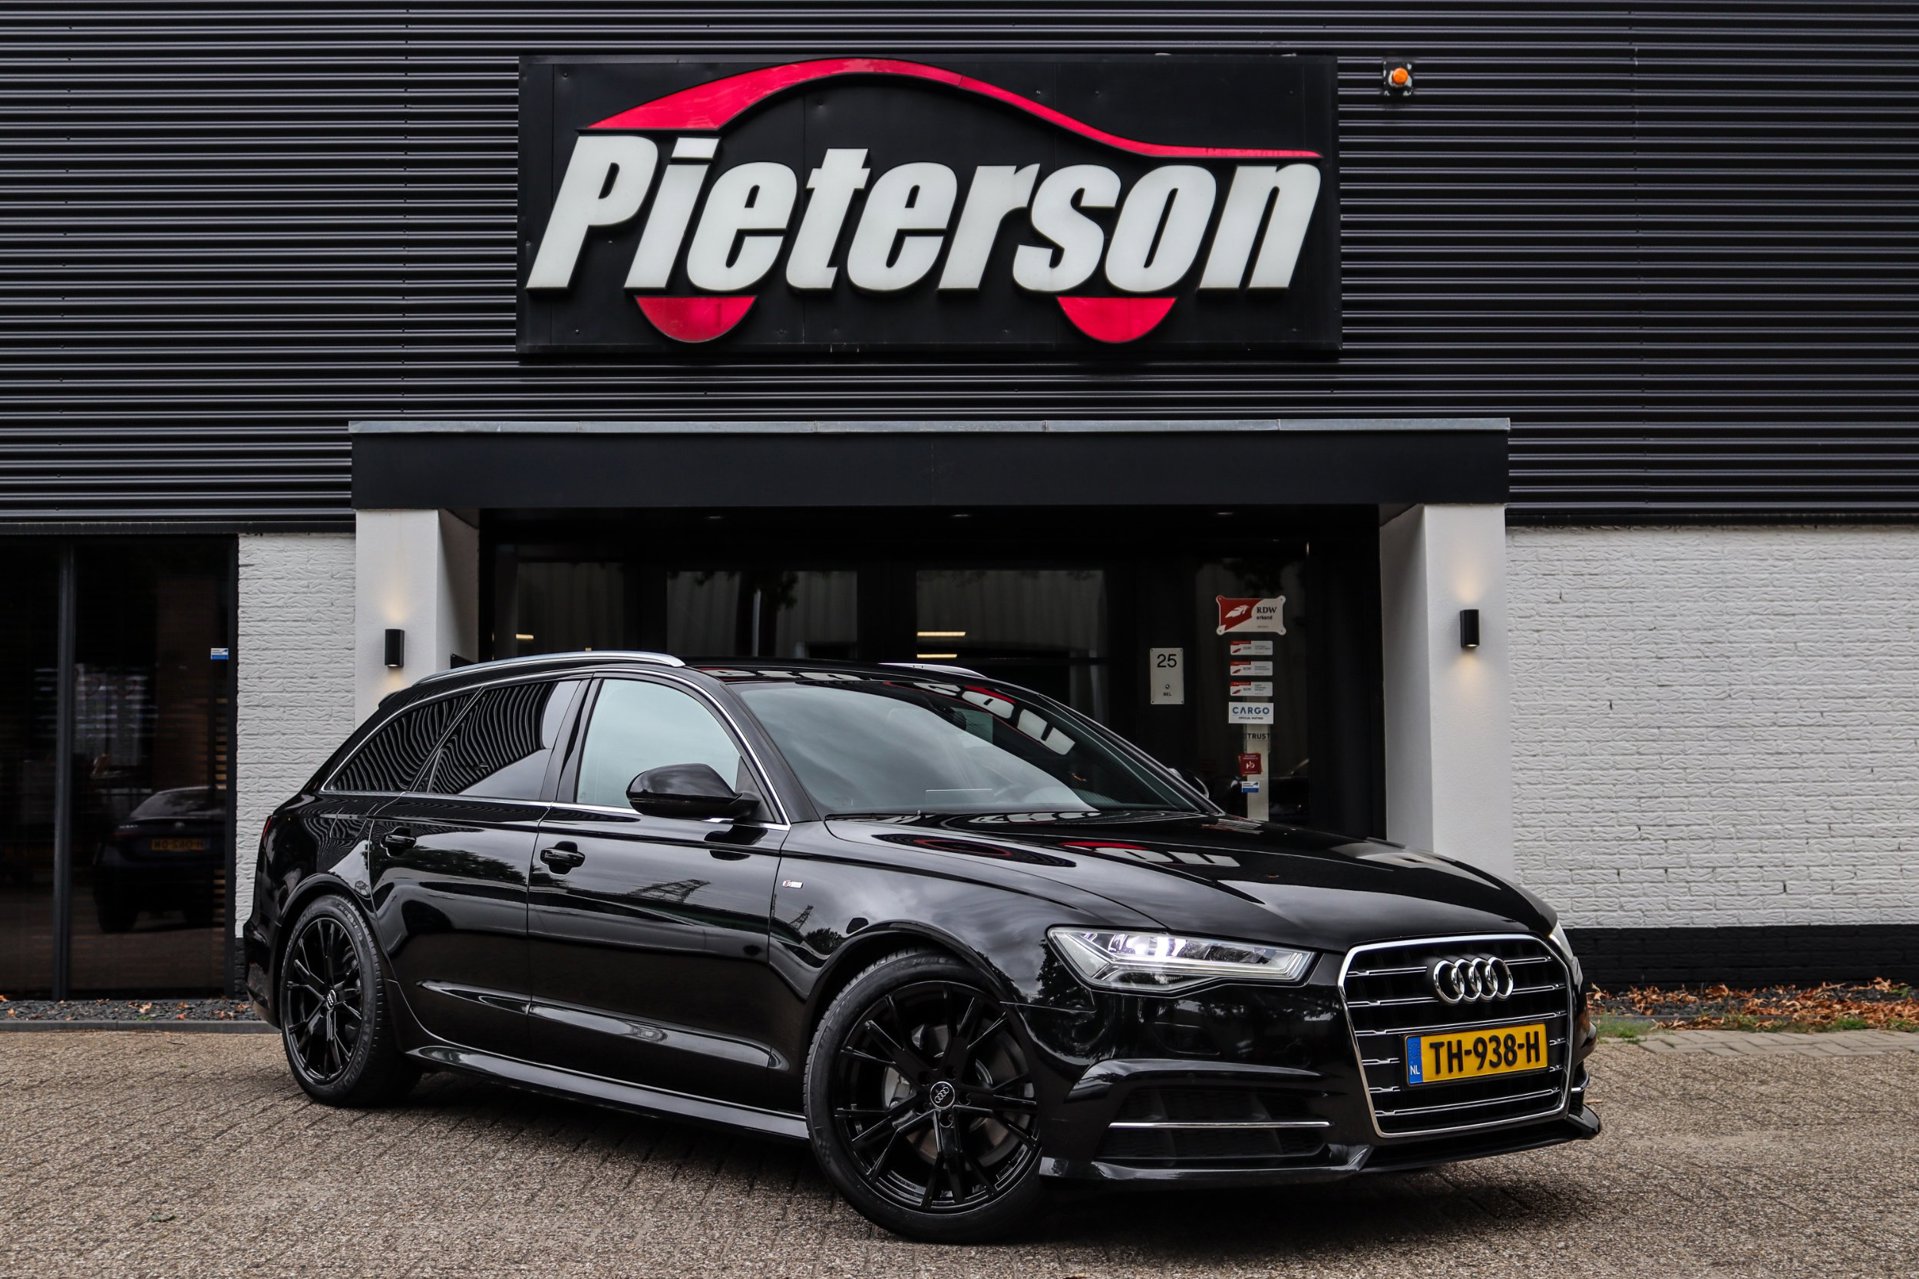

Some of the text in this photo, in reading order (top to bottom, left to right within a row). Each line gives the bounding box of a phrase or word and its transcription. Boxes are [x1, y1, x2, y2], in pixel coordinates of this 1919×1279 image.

[525, 134, 1322, 294] Pieterson
[1256, 606, 1278, 614] RDW
[1157, 653, 1177, 668] 25
[1232, 706, 1270, 715] CARGO
[1429, 1031, 1541, 1075] TH-938-H
[1409, 1065, 1421, 1076] NL
